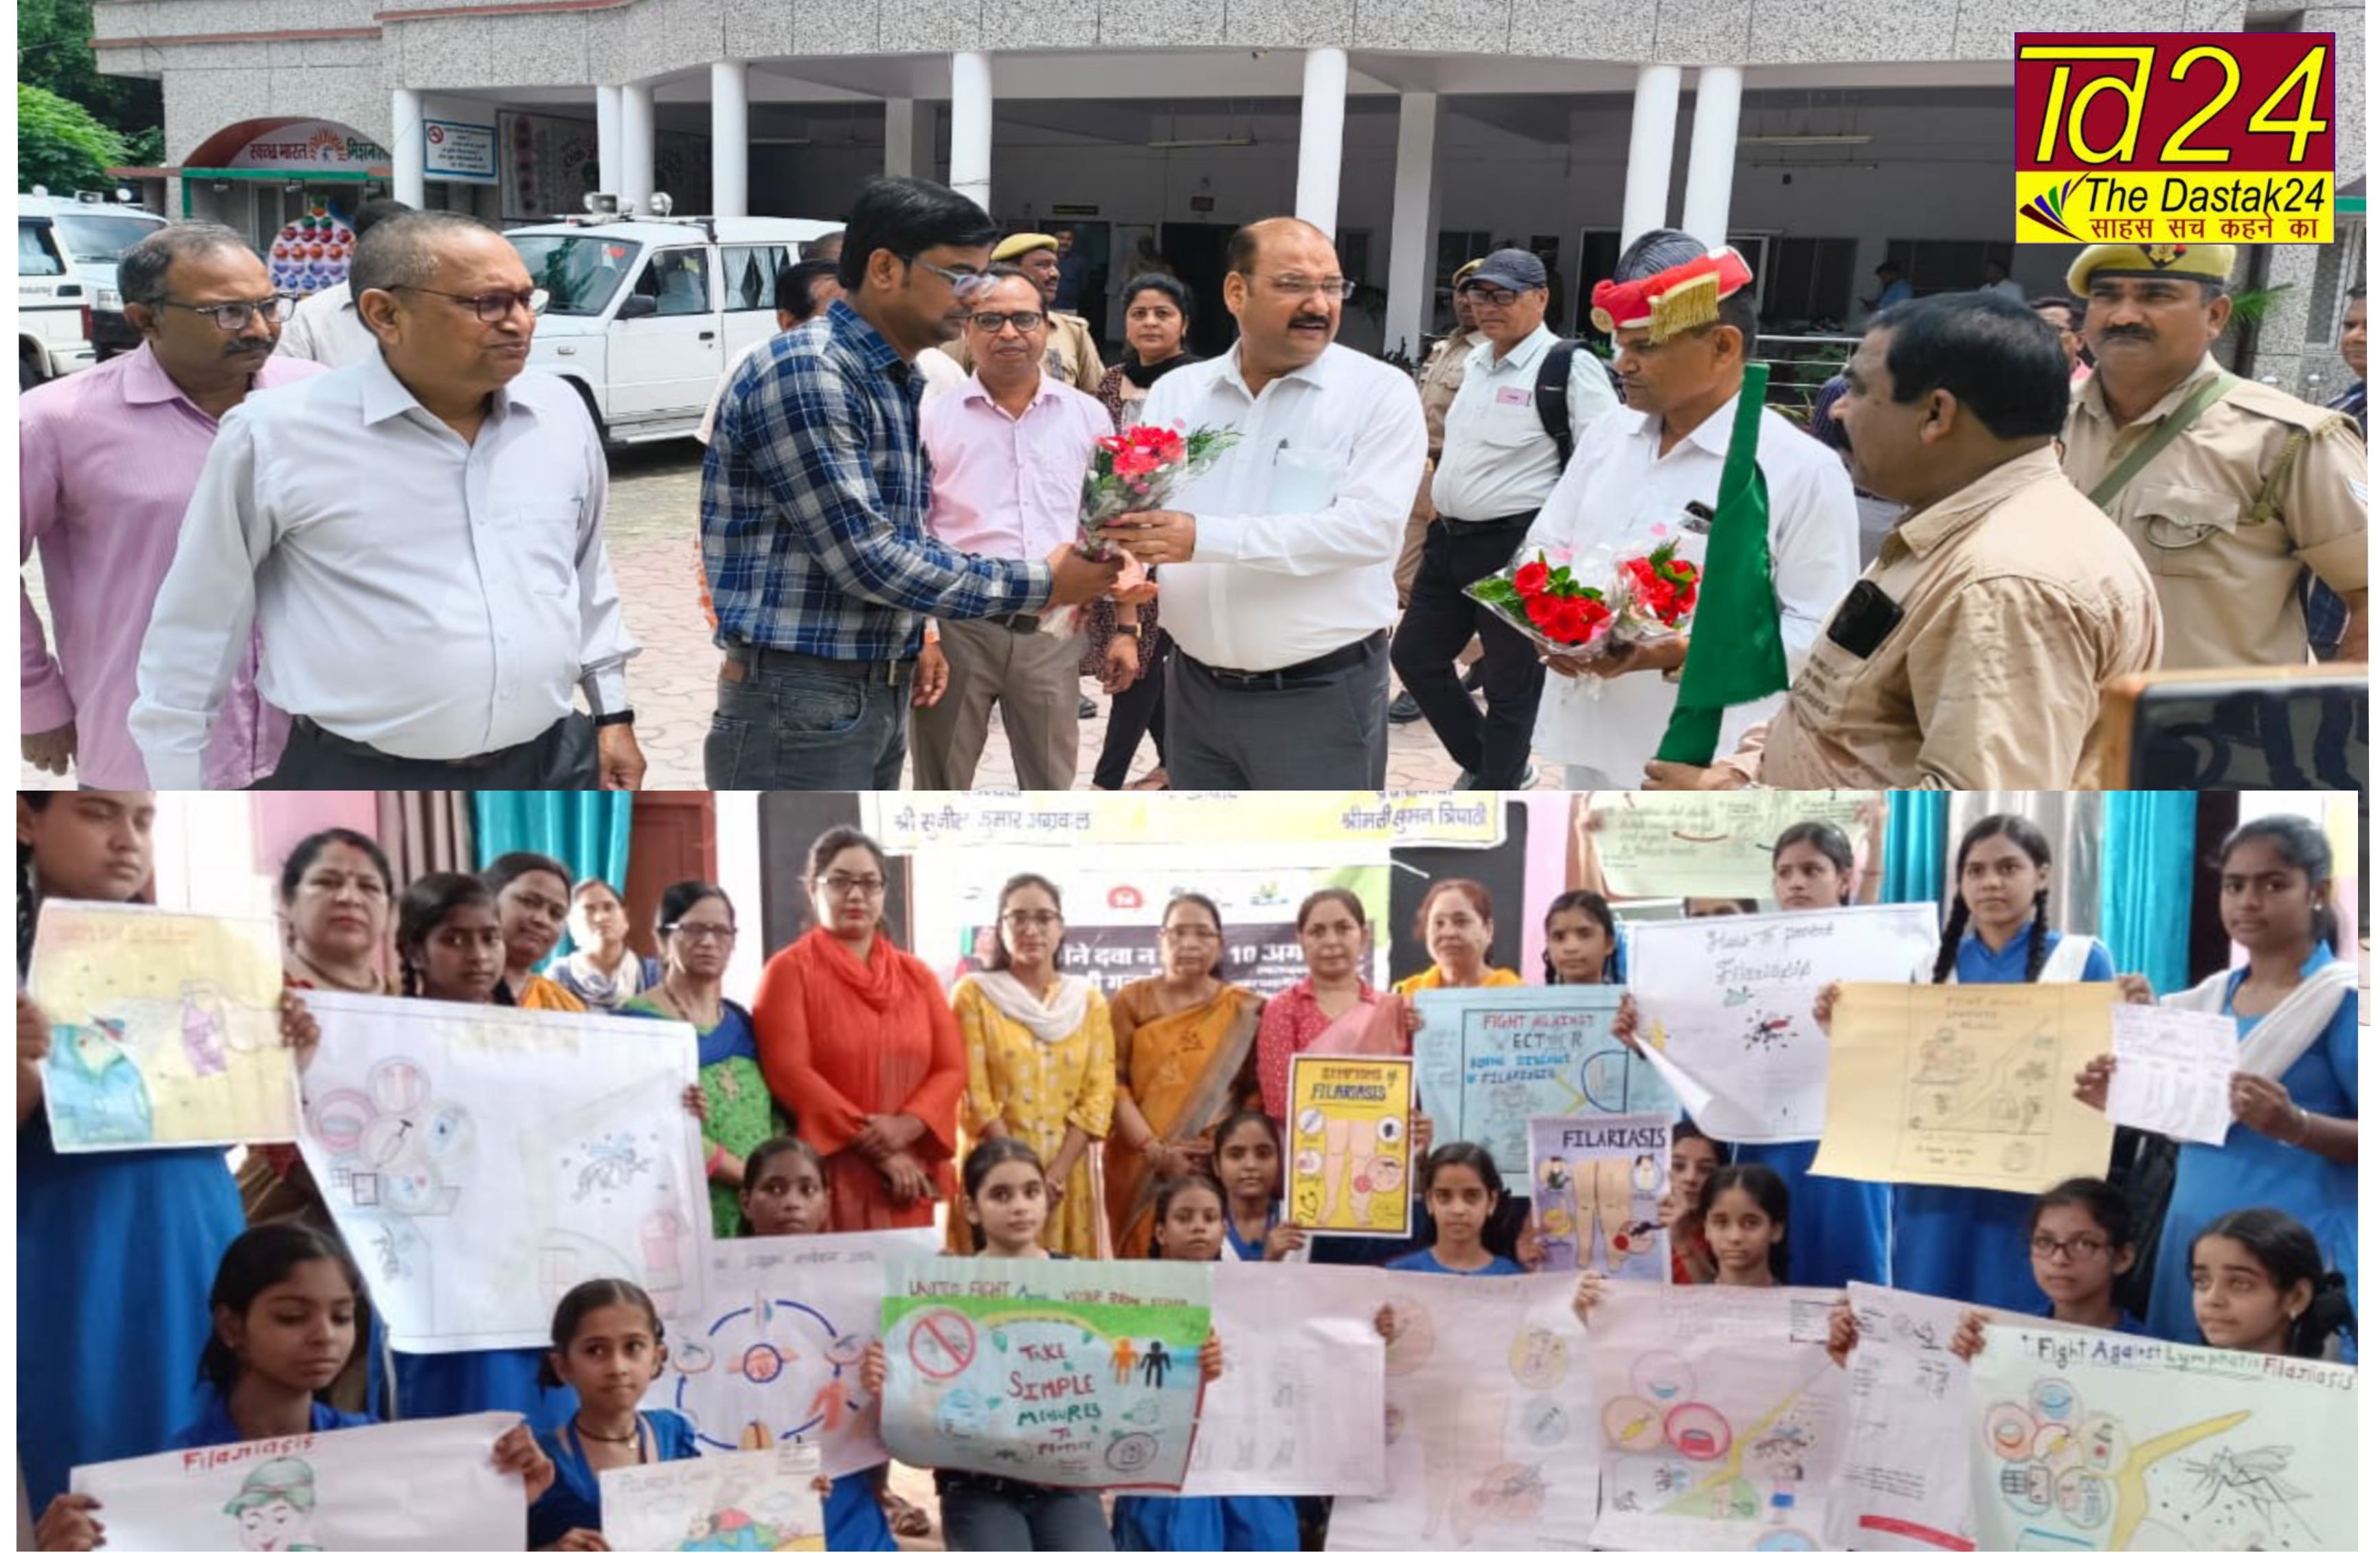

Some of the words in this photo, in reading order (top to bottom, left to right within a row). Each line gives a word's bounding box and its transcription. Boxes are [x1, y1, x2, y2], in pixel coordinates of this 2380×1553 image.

[279, 144, 307, 159] भारत
[1094, 947, 1133, 967] दवा
[1230, 944, 1257, 964] 10
[1483, 1014, 1524, 1029] FIGHT
[1563, 1126, 1665, 1150] FILARIASIS
[2038, 1337, 2088, 1370] Fight
[2092, 1339, 2162, 1365] Against
[1007, 1371, 1095, 1401] SIMPLE
[183, 1434, 315, 1471] Filariasis
